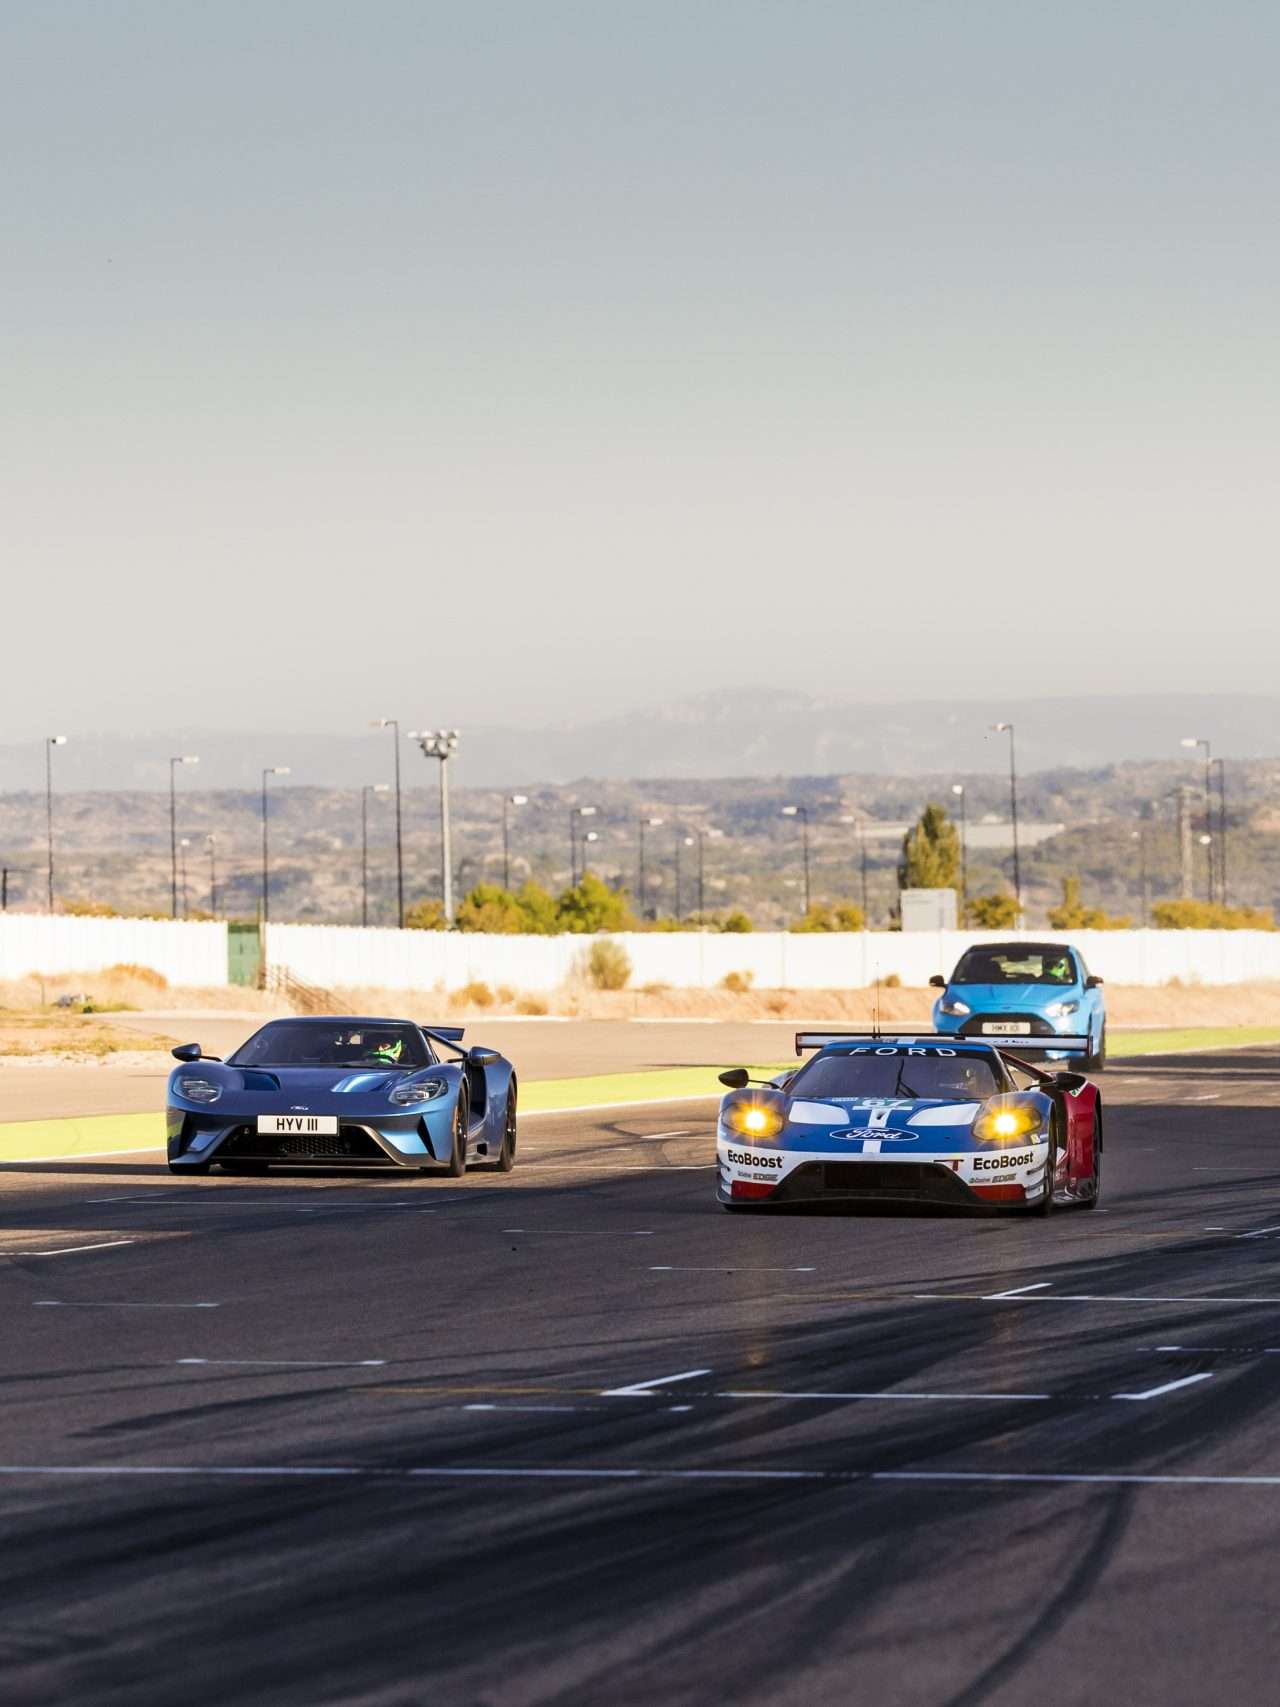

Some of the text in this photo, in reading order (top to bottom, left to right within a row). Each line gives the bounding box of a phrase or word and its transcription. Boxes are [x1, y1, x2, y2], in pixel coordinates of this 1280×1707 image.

[848, 1047, 957, 1057] FORD
[276, 1118, 303, 1130] HYV
[845, 1128, 903, 1139] Ford
[727, 1149, 783, 1169] EcoBoost
[973, 1151, 1034, 1171] EcoBoost
